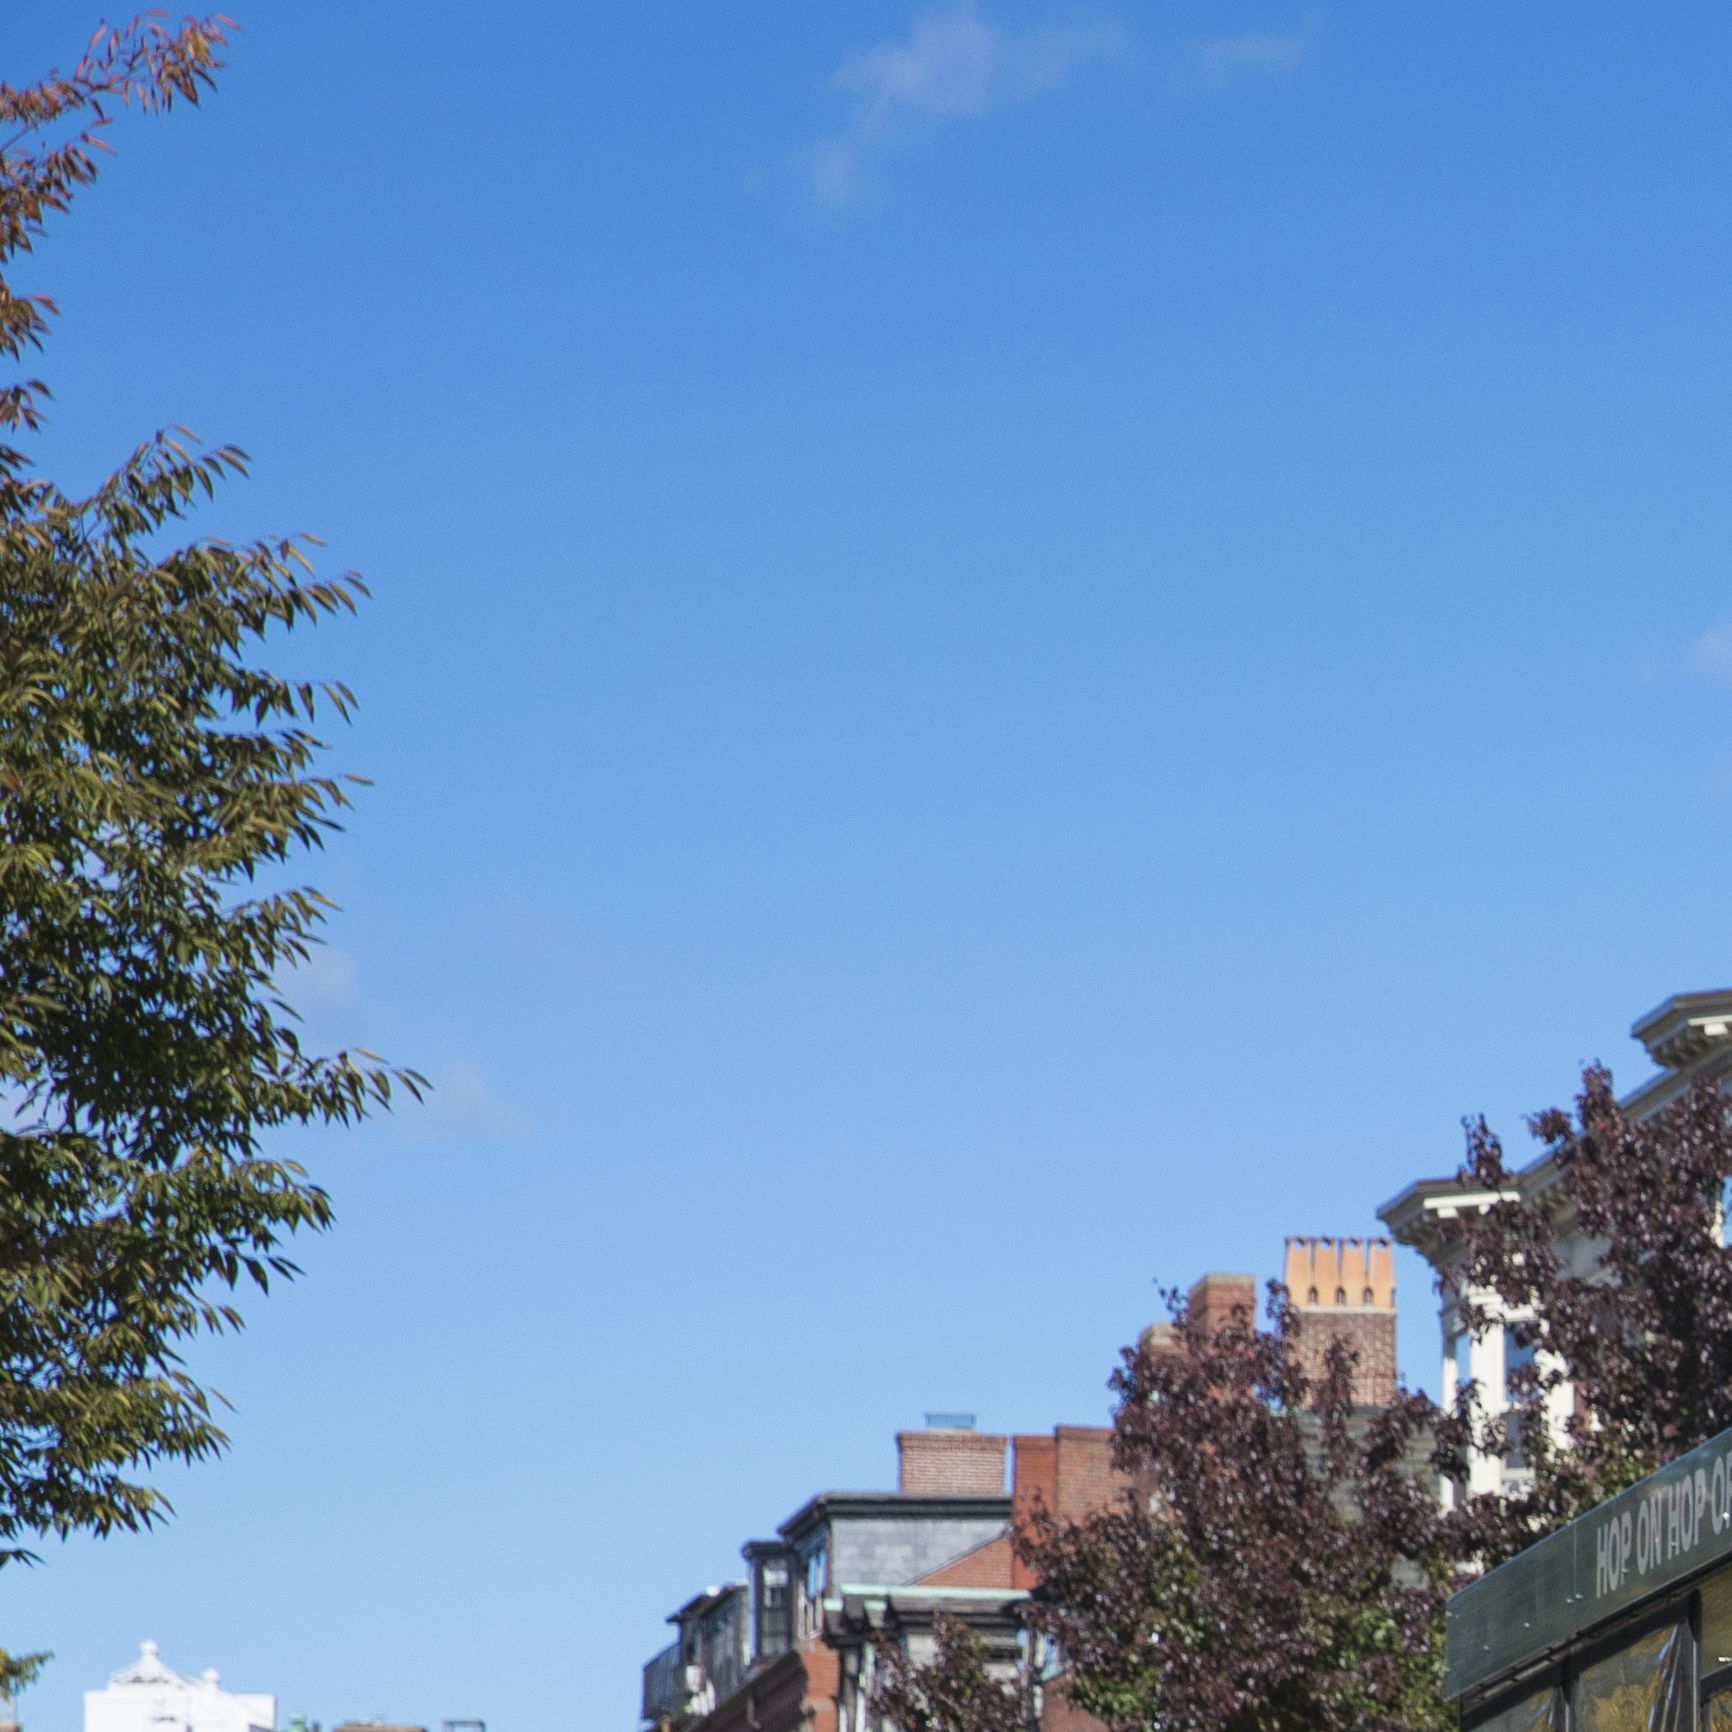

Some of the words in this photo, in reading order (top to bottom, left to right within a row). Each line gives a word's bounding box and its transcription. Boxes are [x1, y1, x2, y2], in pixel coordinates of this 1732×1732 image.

[1595, 1511, 1632, 1599] HOP
[1636, 1487, 1663, 1576] ON
[1667, 1468, 1706, 1561] HOP
